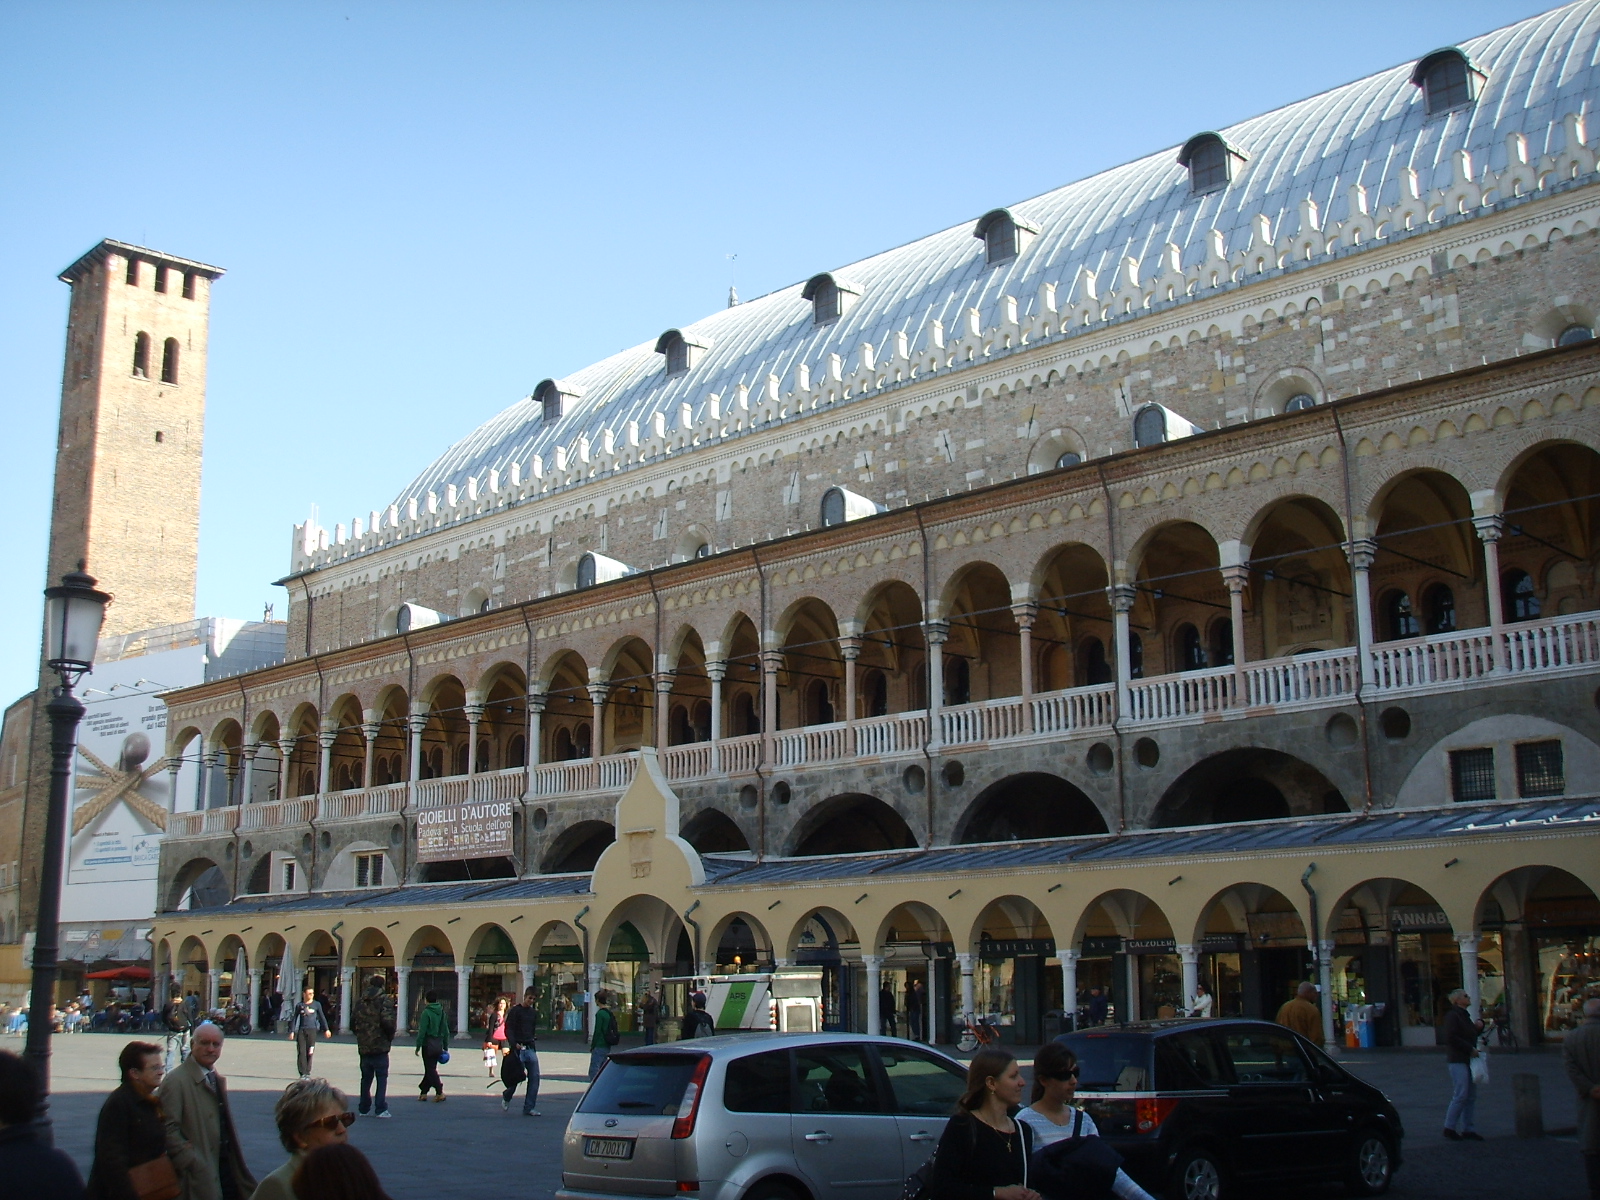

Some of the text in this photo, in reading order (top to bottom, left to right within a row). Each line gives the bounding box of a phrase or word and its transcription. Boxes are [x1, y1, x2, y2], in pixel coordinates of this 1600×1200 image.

[418, 802, 512, 825] GIOIELLI D'AUTORE
[418, 819, 512, 838] Padova e la Scuola dell'oro
[729, 992, 746, 1000] APS
[590, 1140, 626, 1156] CM 700XY
